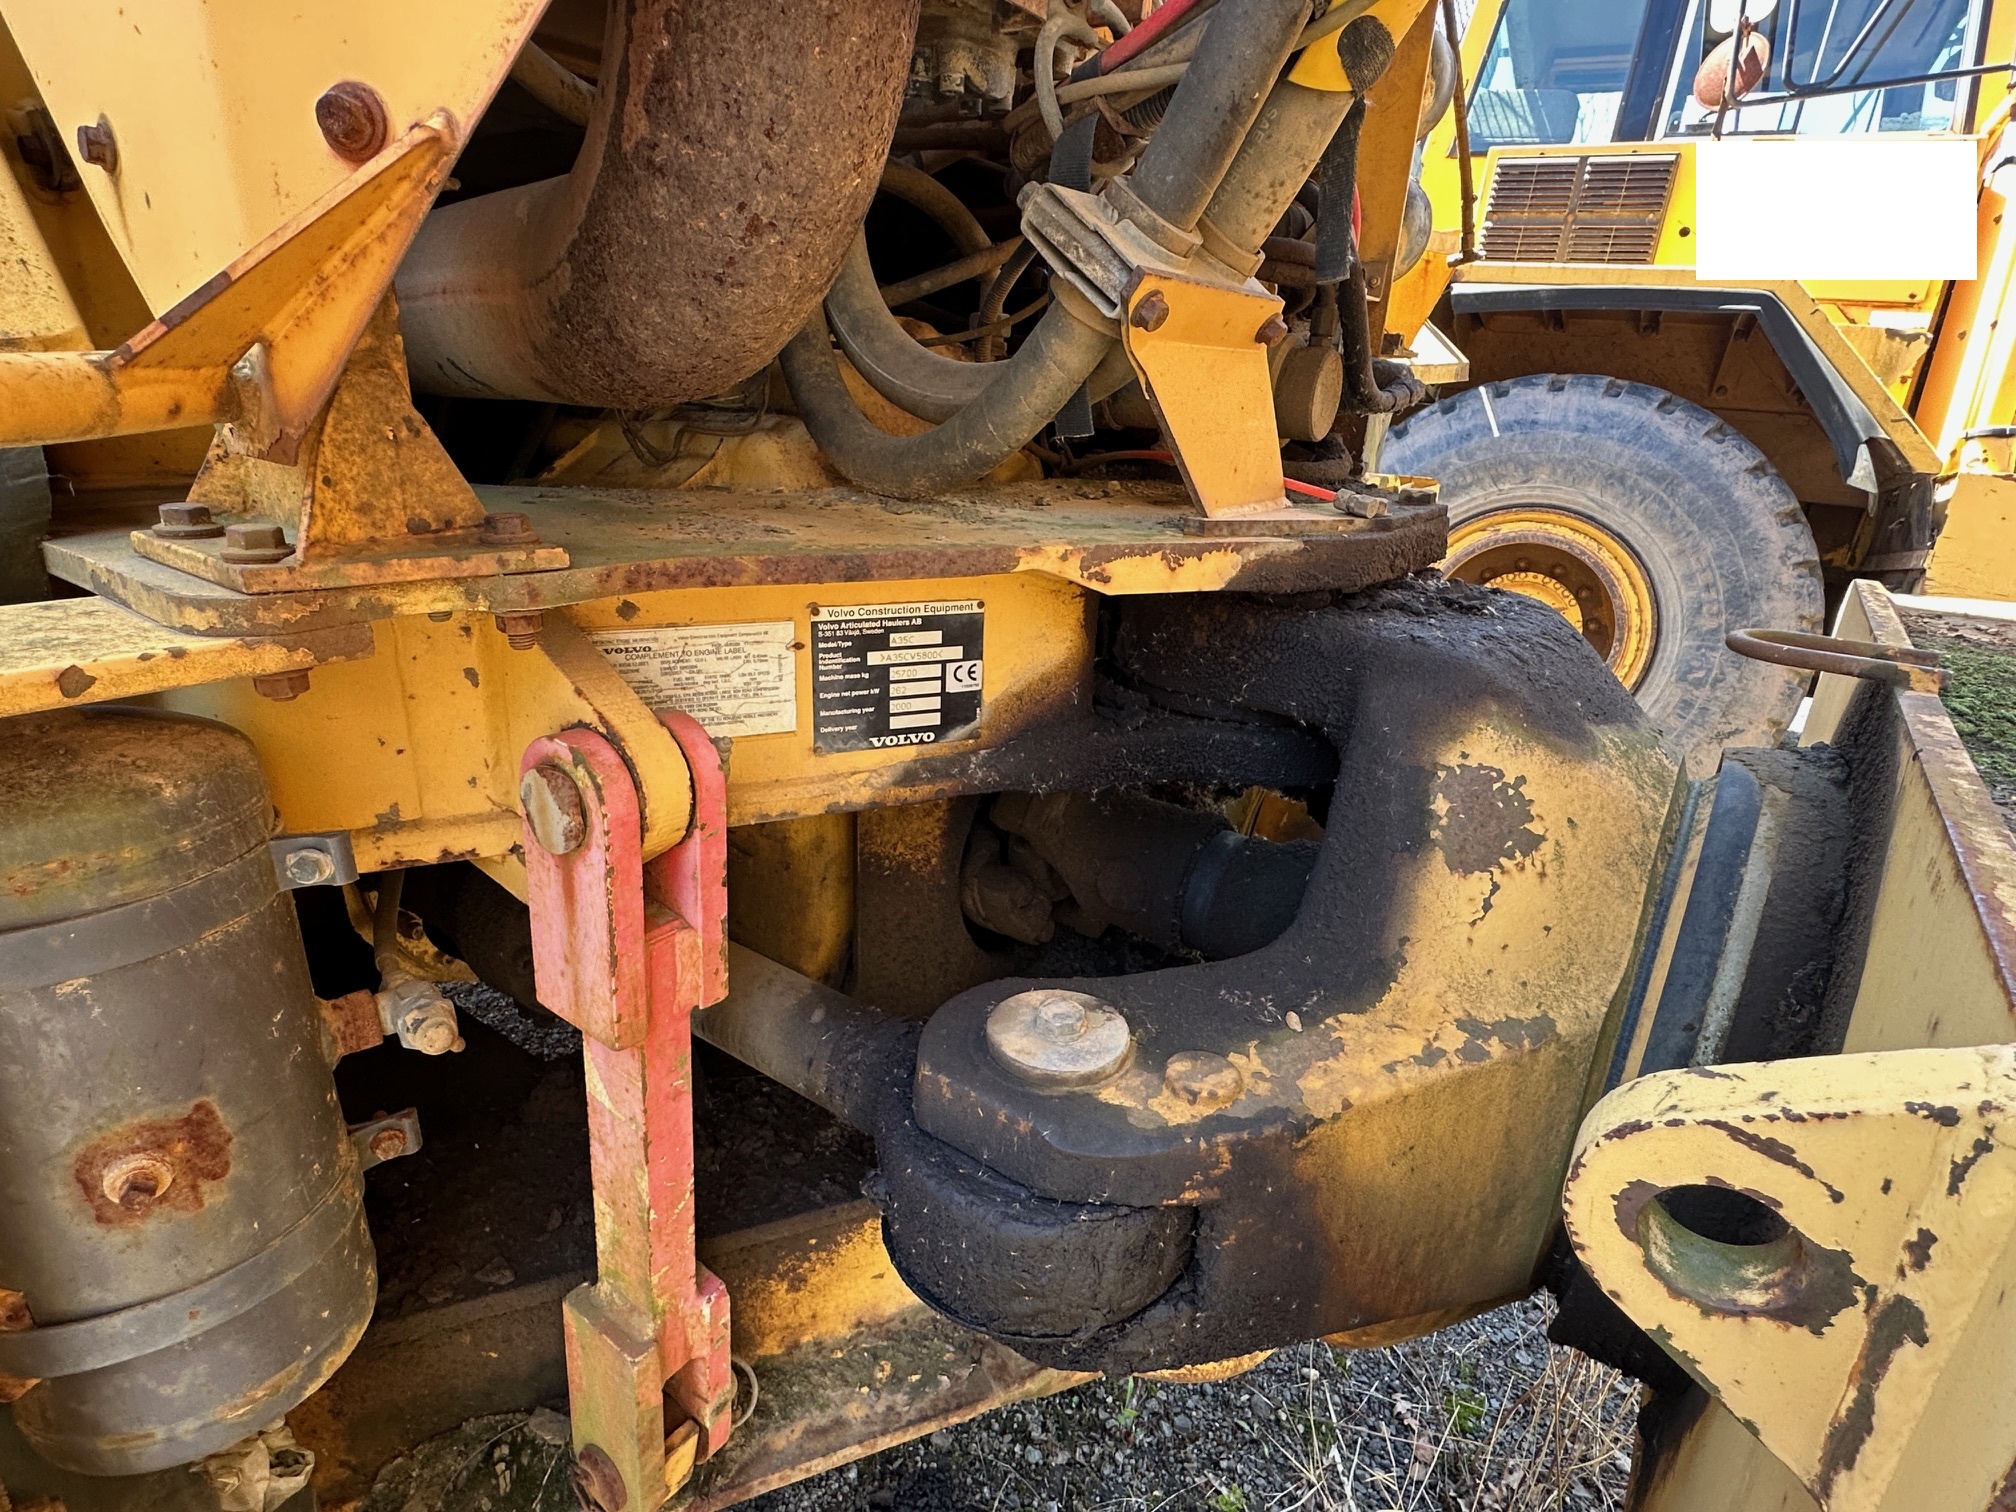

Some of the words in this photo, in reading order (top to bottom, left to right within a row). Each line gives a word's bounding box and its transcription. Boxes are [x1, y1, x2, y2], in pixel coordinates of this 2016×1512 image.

[1252, 108, 1278, 143] SAE
[827, 609, 855, 618] Volvo
[858, 605, 921, 616] Construction
[924, 603, 974, 615] Equipment
[818, 622, 839, 631] Volvo
[840, 620, 881, 630] Articulated
[882, 619, 910, 627] Haulers
[911, 618, 923, 626] AB
[818, 641, 853, 649] Model/Type
[891, 636, 915, 645] A35C
[602, 645, 652, 655] VOLVO
[624, 650, 680, 661] COMPLEMENT
[694, 648, 723, 657] ENGINE
[724, 646, 747, 655] LABEL
[819, 673, 844, 681] Machine
[861, 672, 870, 680] kg
[891, 669, 918, 678] 25700
[953, 663, 977, 683] CE
[819, 692, 841, 700] Engine
[851, 689, 870, 697] power
[891, 686, 907, 695] 262
[819, 707, 862, 717] Manufacturing
[891, 702, 912, 711] 2000
[820, 725, 844, 733] Delivery
[869, 732, 936, 747] VOLVO
